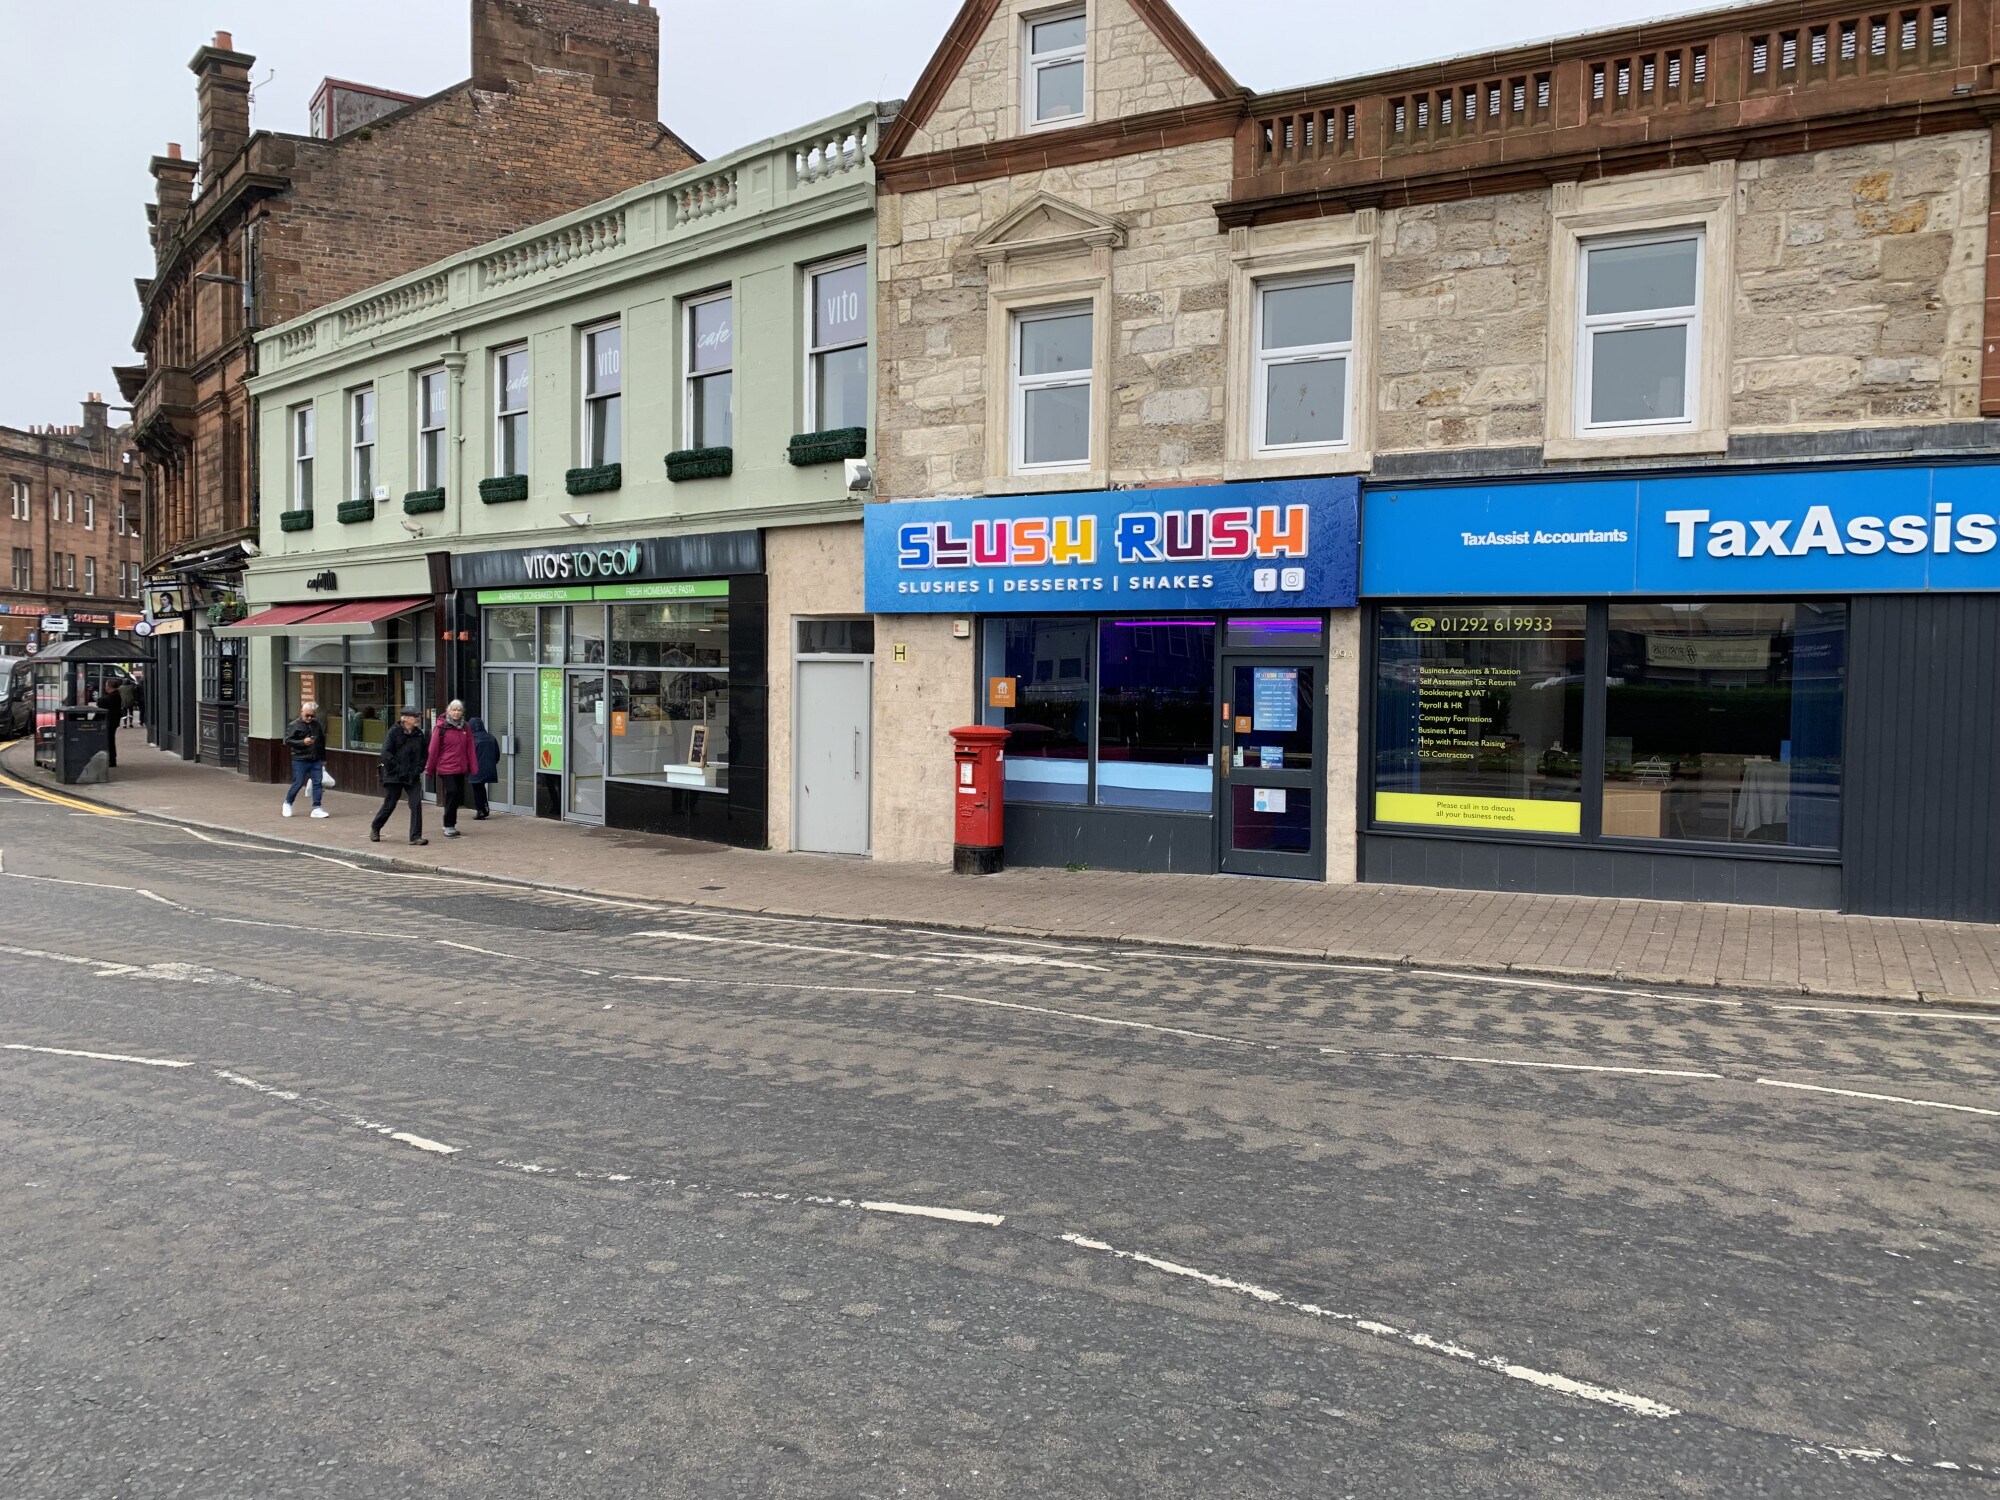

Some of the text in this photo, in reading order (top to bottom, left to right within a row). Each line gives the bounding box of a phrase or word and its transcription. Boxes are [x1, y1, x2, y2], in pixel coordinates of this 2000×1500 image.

[827, 290, 858, 325] vito
[697, 321, 732, 350] cafe
[598, 347, 619, 377] vito
[898, 503, 1309, 569] SLUSH RUSH
[1461, 528, 1628, 546] TaxAssist Accountants
[1665, 502, 2000, 558] TaxAssis
[523, 548, 628, 580] VITO'S TO GO
[626, 584, 696, 596] FRESH HOMEMADE PASTA
[898, 580, 980, 594] SLUSHES
[1003, 577, 1104, 592] DESSERTS
[1129, 574, 1214, 590] SHAKES
[498, 590, 568, 600] AUTHENTIC STONEBAKED PIZZA
[1441, 617, 1552, 632] 01292 619933
[894, 646, 906, 660] H
[1332, 649, 1354, 659] 29A
[1419, 689, 1463, 698] Bookkeeping
[1418, 702, 1442, 710] Payroll
[1418, 714, 1492, 722] Company Formations
[543, 732, 562, 746] pizza
[1418, 738, 1434, 746] Help
[1481, 740, 1506, 749] Raising
[1432, 750, 1474, 759] Contractors
[1436, 801, 1458, 809] Please
[1491, 804, 1516, 812] discuss
